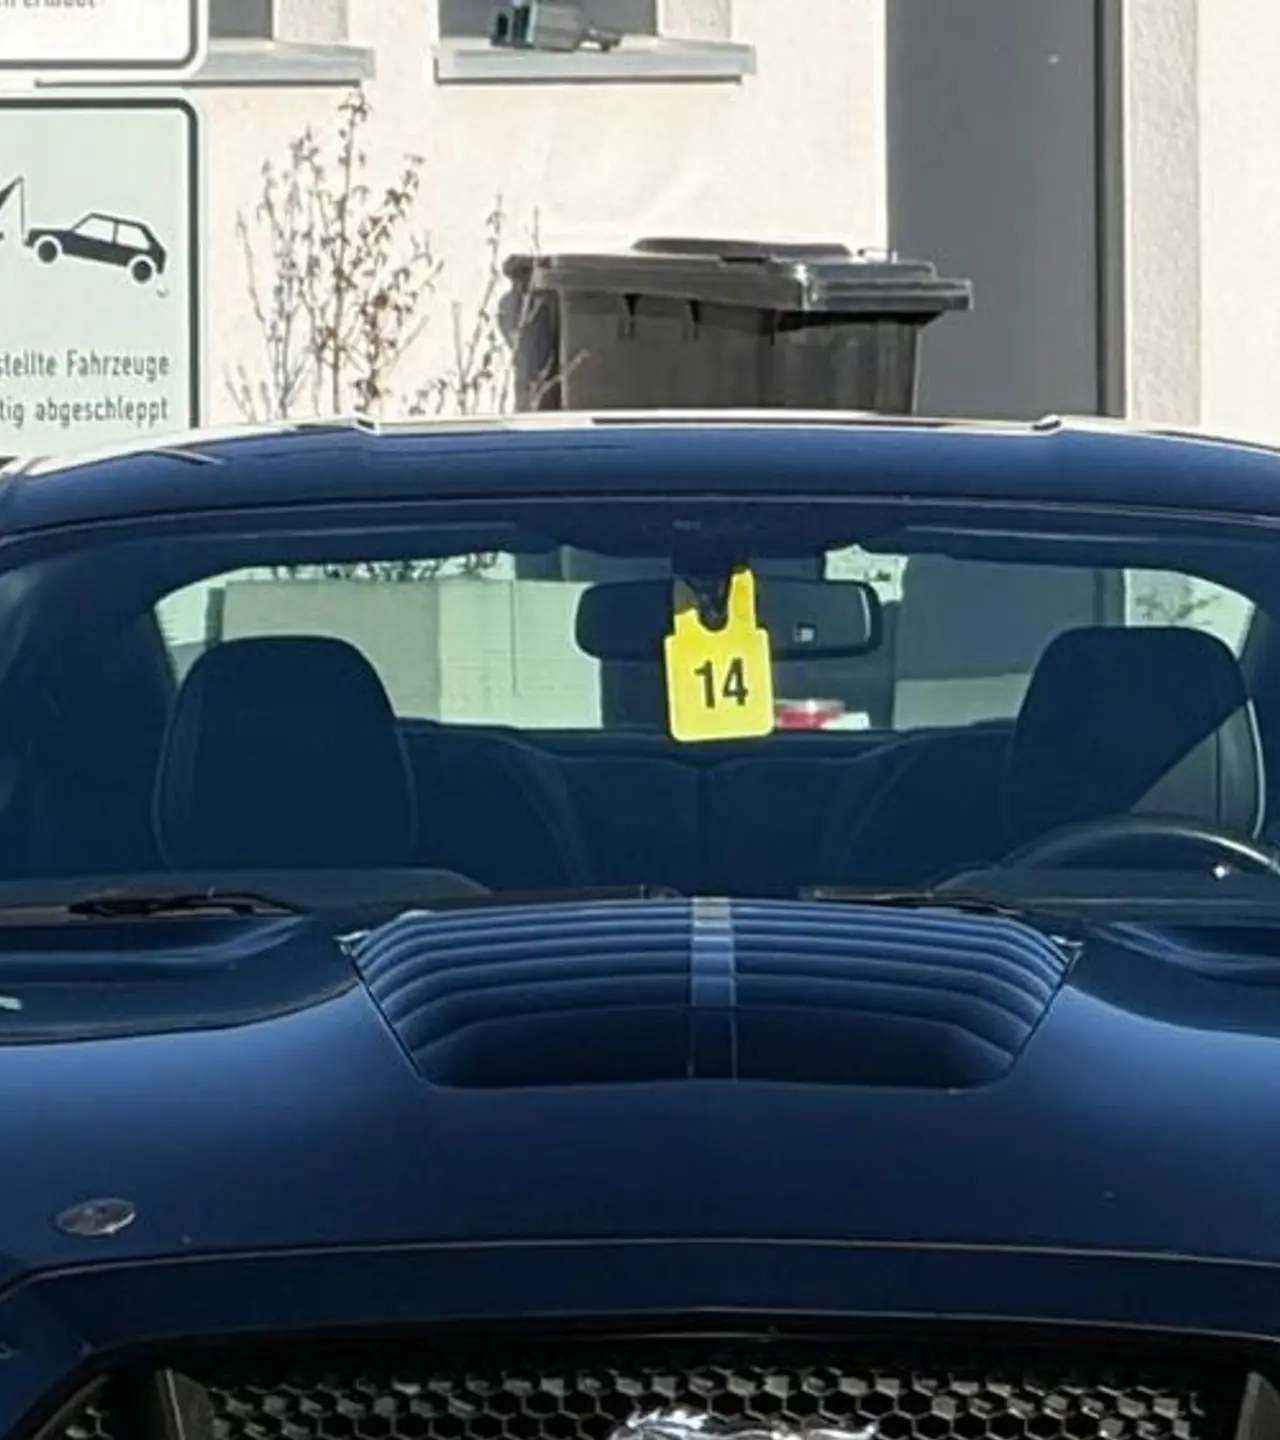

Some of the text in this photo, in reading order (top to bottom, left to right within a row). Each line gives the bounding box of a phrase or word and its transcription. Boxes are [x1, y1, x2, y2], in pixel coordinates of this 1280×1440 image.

[65, 349, 171, 379] Fahrzeuge
[34, 396, 169, 430] abgeschleppt
[692, 656, 749, 710] 14
